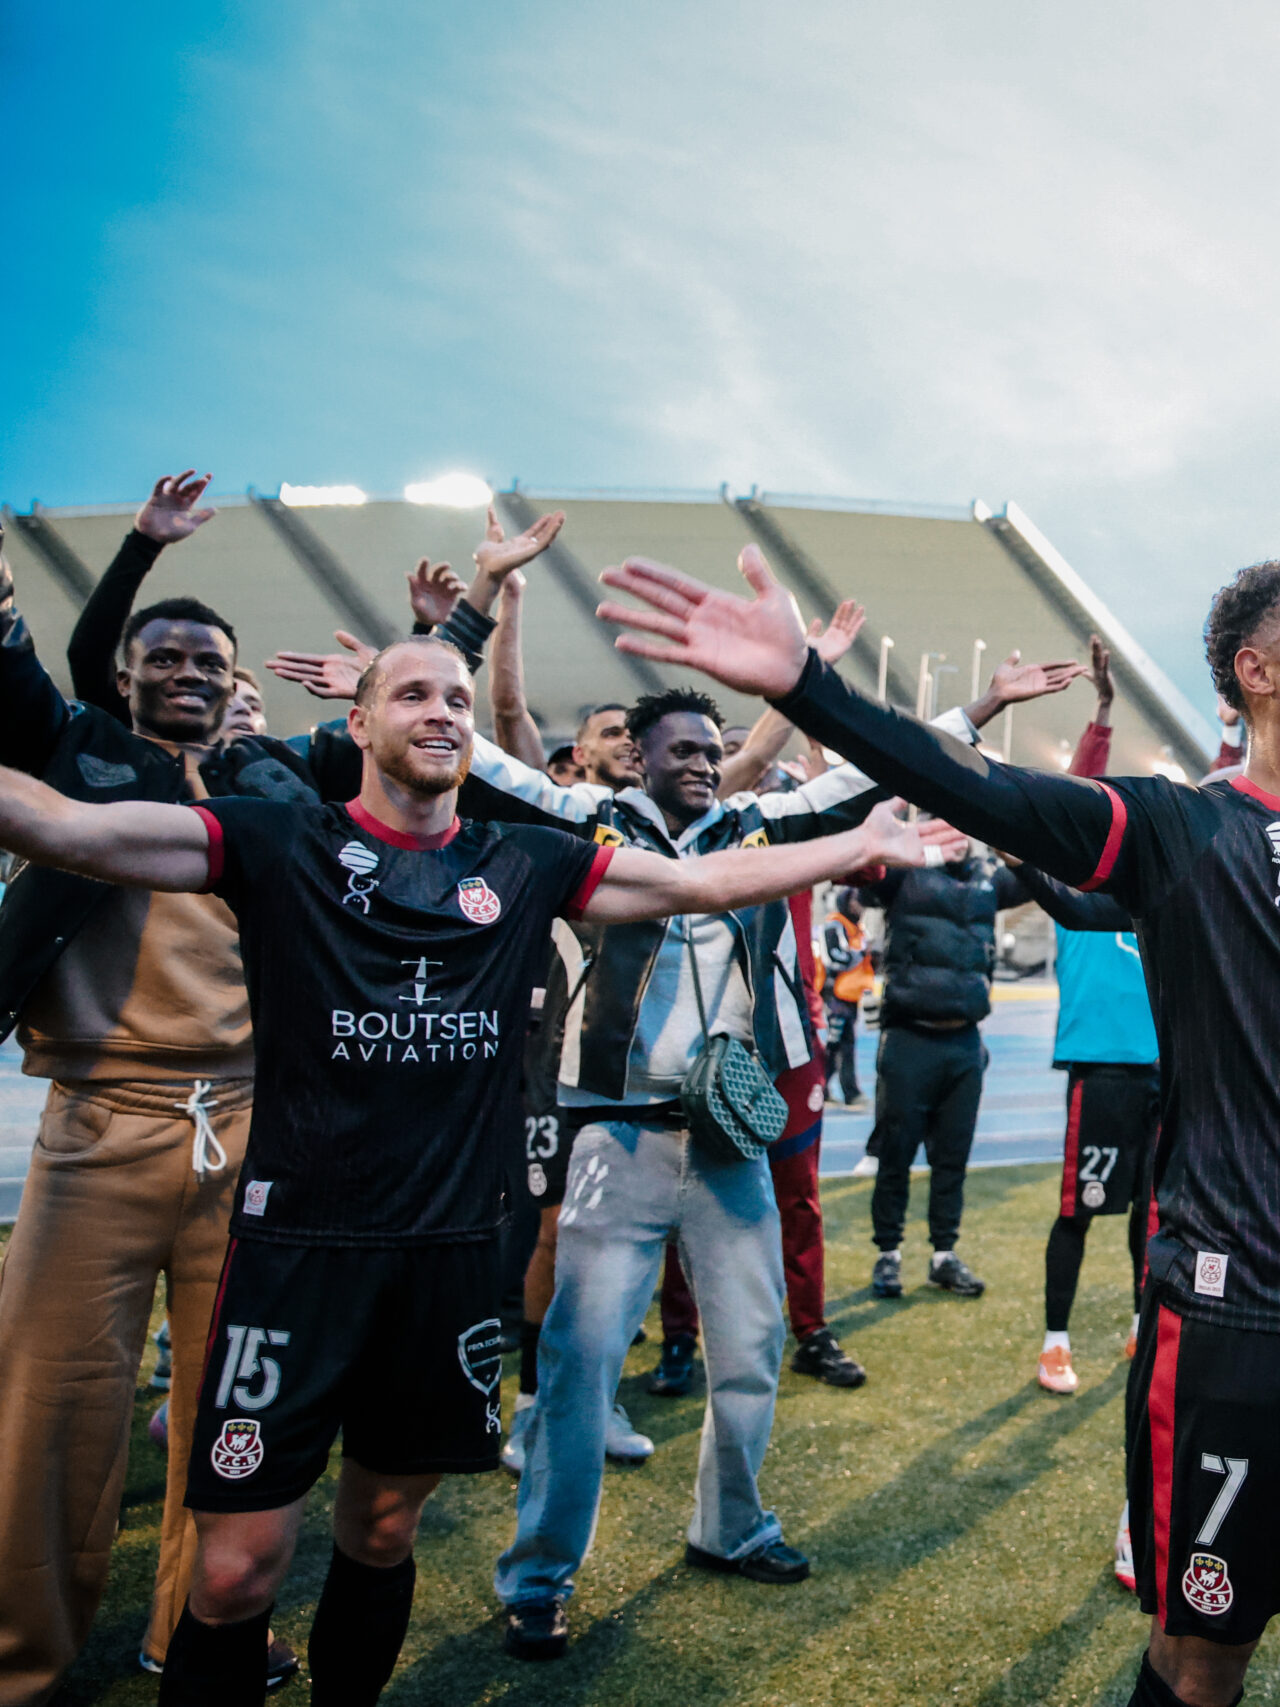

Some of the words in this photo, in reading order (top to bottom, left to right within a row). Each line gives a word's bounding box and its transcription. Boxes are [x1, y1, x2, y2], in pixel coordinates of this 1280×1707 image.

[331, 1009, 499, 1040] BOUTSEN
[331, 1041, 499, 1063] AVIATION
[525, 1115, 559, 1159] 23
[1079, 1145, 1119, 1184] 27
[215, 1325, 291, 1412] 15
[1194, 1452, 1249, 1547] 7
